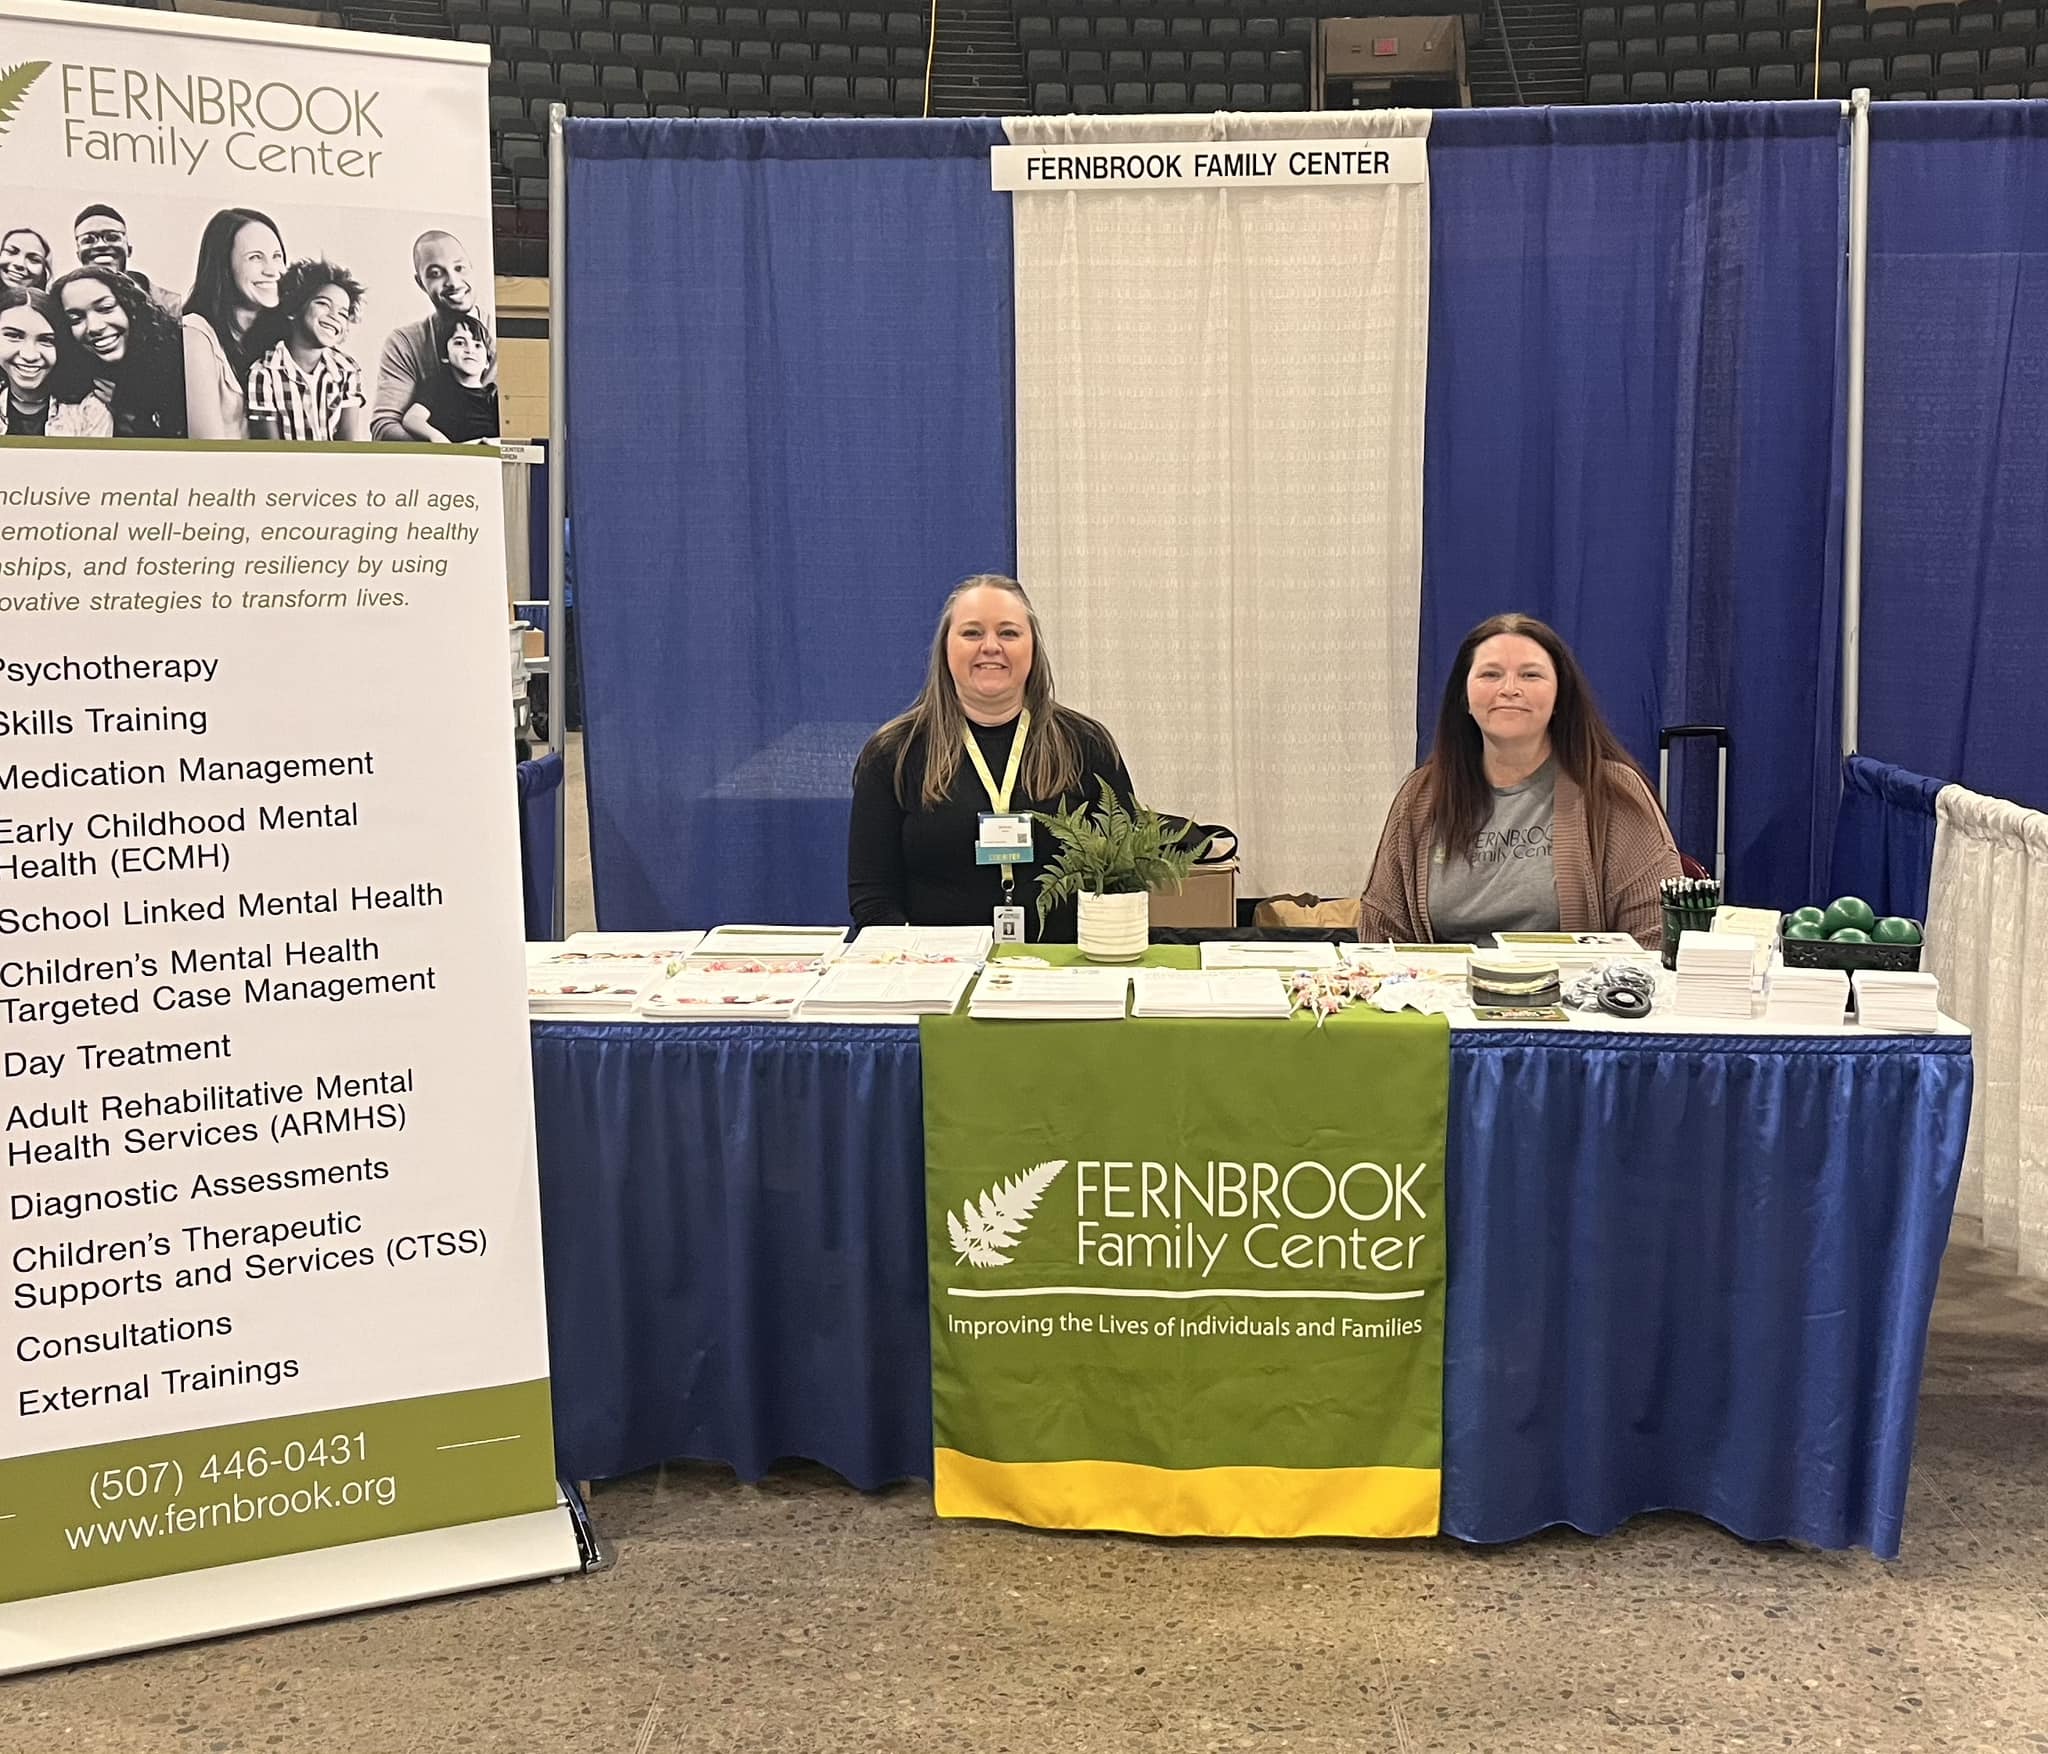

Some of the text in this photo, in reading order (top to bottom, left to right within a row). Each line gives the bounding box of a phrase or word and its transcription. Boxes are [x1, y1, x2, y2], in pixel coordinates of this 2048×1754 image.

[63, 64, 383, 138] FERNBROOK
[66, 119, 382, 178] Family Center
[1028, 152, 1389, 180] FERNBROOK FAMILY CENTER
[101, 488, 178, 506] mental
[188, 488, 255, 507] health
[266, 489, 357, 507] services
[367, 490, 385, 507] to
[395, 489, 419, 507] all
[427, 494, 478, 511] ages,
[2, 522, 479, 544] emotional well-being, encouraging healthy
[84, 557, 127, 575] and
[137, 557, 235, 578] fostering
[245, 556, 349, 577] resiliency
[358, 555, 383, 577] by
[392, 555, 447, 576] using
[90, 591, 202, 613] strategies
[212, 592, 232, 608] to
[243, 589, 346, 608] transform
[357, 589, 408, 606] lives.
[85, 706, 206, 734] Training
[180, 752, 373, 783] Management
[88, 808, 244, 839] Childhood
[260, 802, 357, 830] Mental
[0, 843, 229, 879] Health (ECMH)
[1513, 844, 1553, 859] Cent
[0, 883, 442, 934] School Linked Mental Health
[0, 937, 378, 987] Children’s Mental Health
[0, 967, 435, 1024] Targeted Case Management
[5, 1035, 231, 1078] Day Treatment
[6, 1069, 412, 1131] Adult Rehabilitative Mental
[9, 1104, 405, 1166] Health Services (ARMHS)
[11, 1158, 388, 1220] Diagnostic Assessments
[1078, 1161, 1426, 1221] FERNBROOK
[13, 1211, 362, 1272] Children’s Therapeutic
[1079, 1222, 1425, 1277] Family Center
[15, 1229, 486, 1308] Supports and Services (CTSS)
[17, 1317, 232, 1361] Consultations
[949, 1312, 1422, 1339] Improving the Lives of Individuals and Families
[18, 1359, 299, 1416] External Trainings
[91, 1431, 369, 1508] (507) 446-0431
[65, 1472, 396, 1550] www.fernbrook.org
